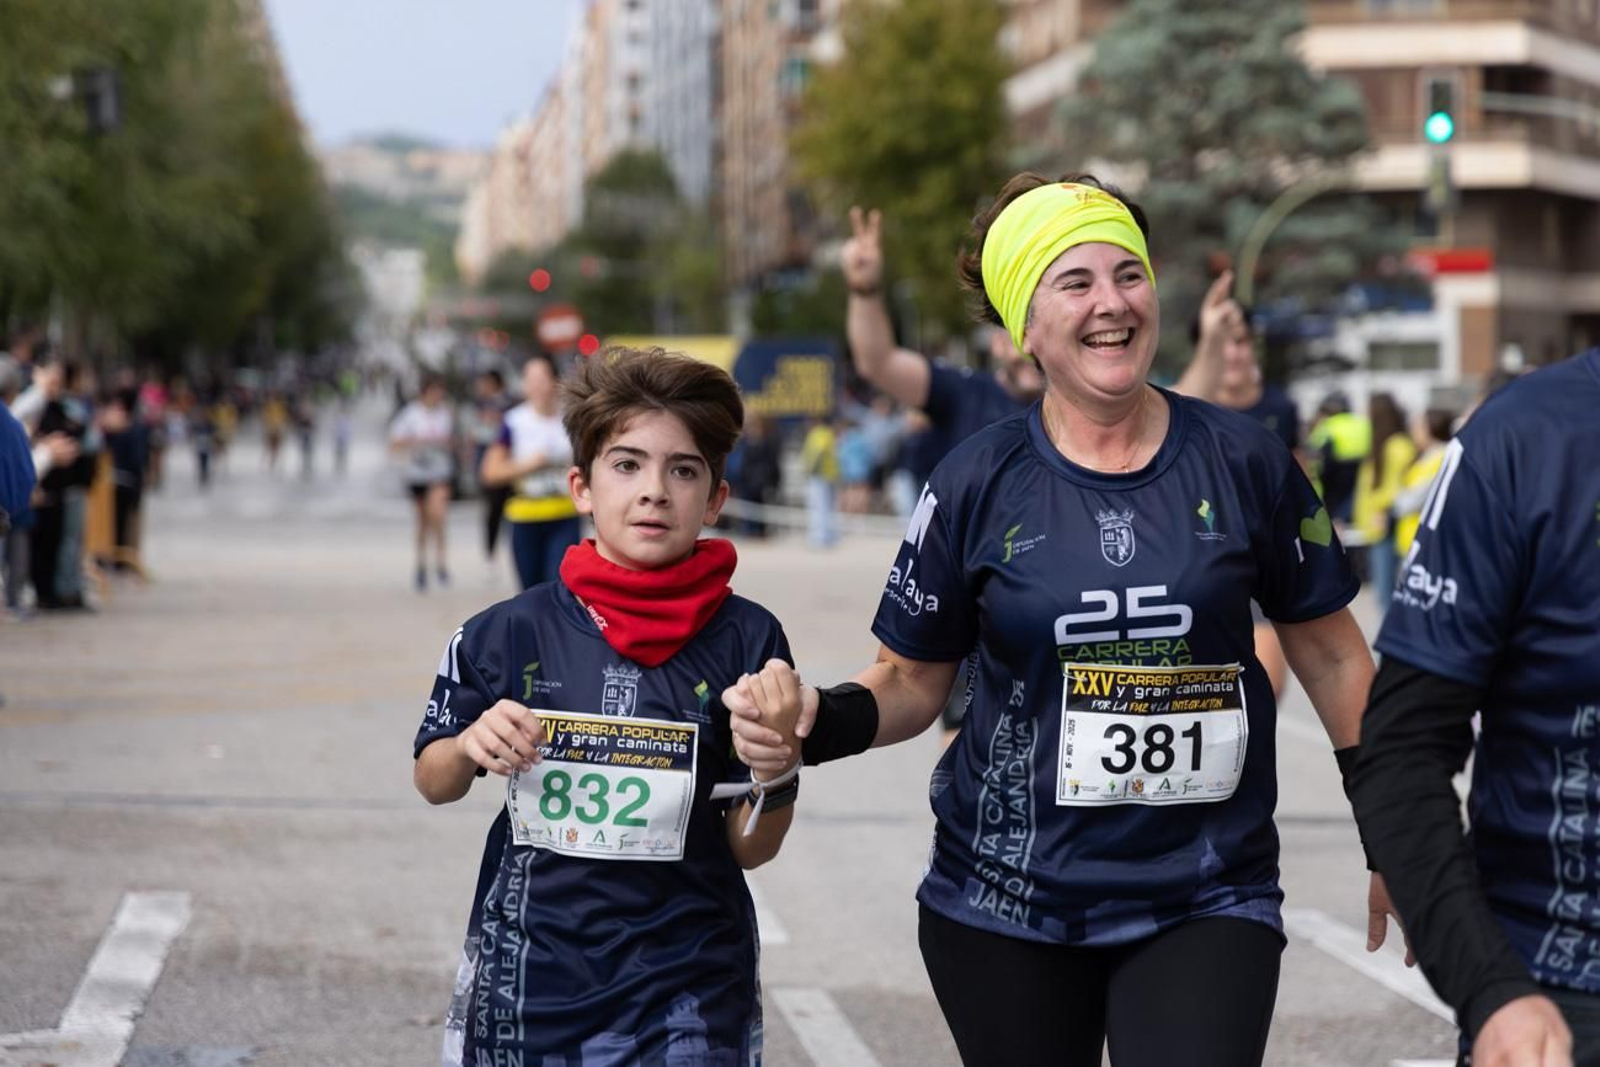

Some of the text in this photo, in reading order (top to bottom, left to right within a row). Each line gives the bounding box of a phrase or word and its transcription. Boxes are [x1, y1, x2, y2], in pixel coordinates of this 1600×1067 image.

[1054, 584, 1193, 646] 25
[1057, 638, 1190, 660] CARRERA
[1072, 671, 1237, 697] XXV CARRERA POPULAR
[1116, 681, 1234, 700] y gran caminata
[1091, 700, 1112, 711] POR
[1113, 701, 1130, 712] LA
[1130, 702, 1149, 713] PAZ
[1157, 702, 1170, 712] LA
[556, 732, 688, 754] y gran caminata
[558, 721, 619, 737] CARRERA
[622, 726, 689, 743] POPULAR
[553, 749, 567, 759] LA
[567, 750, 585, 760] PAZ
[594, 752, 609, 762] LA
[1101, 720, 1202, 774] 381
[539, 769, 651, 828] 832
[477, 962, 496, 1038] SANTA
[495, 1008, 516, 1041] DE
